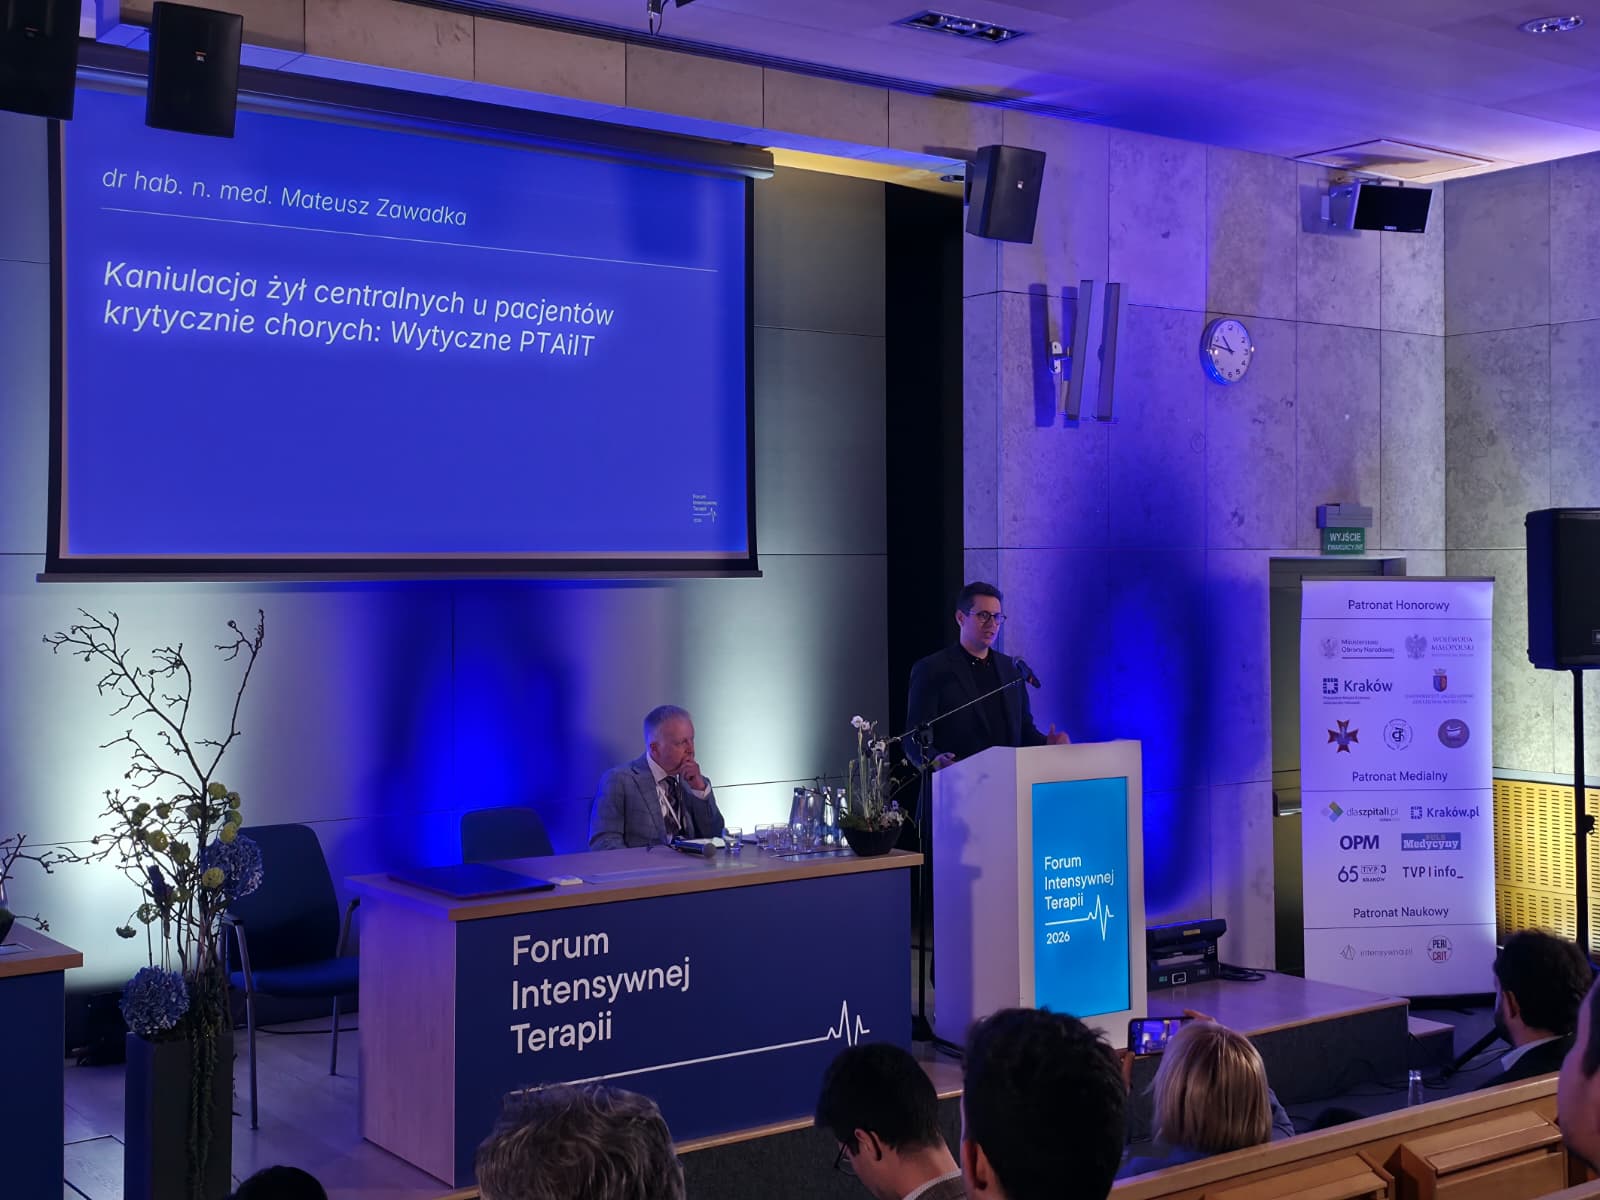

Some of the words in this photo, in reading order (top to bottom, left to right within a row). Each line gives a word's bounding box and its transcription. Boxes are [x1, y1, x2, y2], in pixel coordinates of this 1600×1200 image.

[102, 168, 127, 188] dr
[134, 170, 183, 195] hab.
[192, 181, 211, 197] n.
[220, 183, 272, 205] med.
[281, 187, 370, 215] Mateusz
[376, 198, 467, 226] Zawadka
[103, 261, 257, 302] Kaniulacja
[266, 275, 308, 306] żył
[313, 284, 465, 317] centralnych
[473, 298, 488, 316] u
[494, 299, 614, 326] pacjentów
[103, 299, 255, 334] krytycznie
[264, 312, 382, 345] chorych:
[391, 320, 512, 353] Wytyczne
[1348, 599, 1393, 611] Patronat
[1395, 599, 1450, 613] Honorowy
[1344, 679, 1393, 693] Kraków
[1352, 771, 1397, 783] Patronat
[1399, 770, 1448, 783] Medialny
[1426, 804, 1479, 819] Kraków.pl
[1339, 834, 1380, 850] OPM
[1403, 839, 1459, 850] Medycyny
[1044, 856, 1082, 871] Forum
[1380, 864, 1388, 874] 3
[1044, 868, 1114, 891] Intensywnej
[1337, 865, 1359, 883] 65
[1402, 866, 1426, 878] TVP
[1044, 892, 1084, 911] Terapii
[1353, 908, 1399, 918] Patronat
[1401, 906, 1449, 918] Naukowy
[1046, 930, 1071, 945] 2026
[1432, 939, 1447, 949] PERI
[511, 931, 610, 966] Forum
[511, 956, 690, 1010] Intensywnej
[510, 1010, 612, 1055] Terapii
